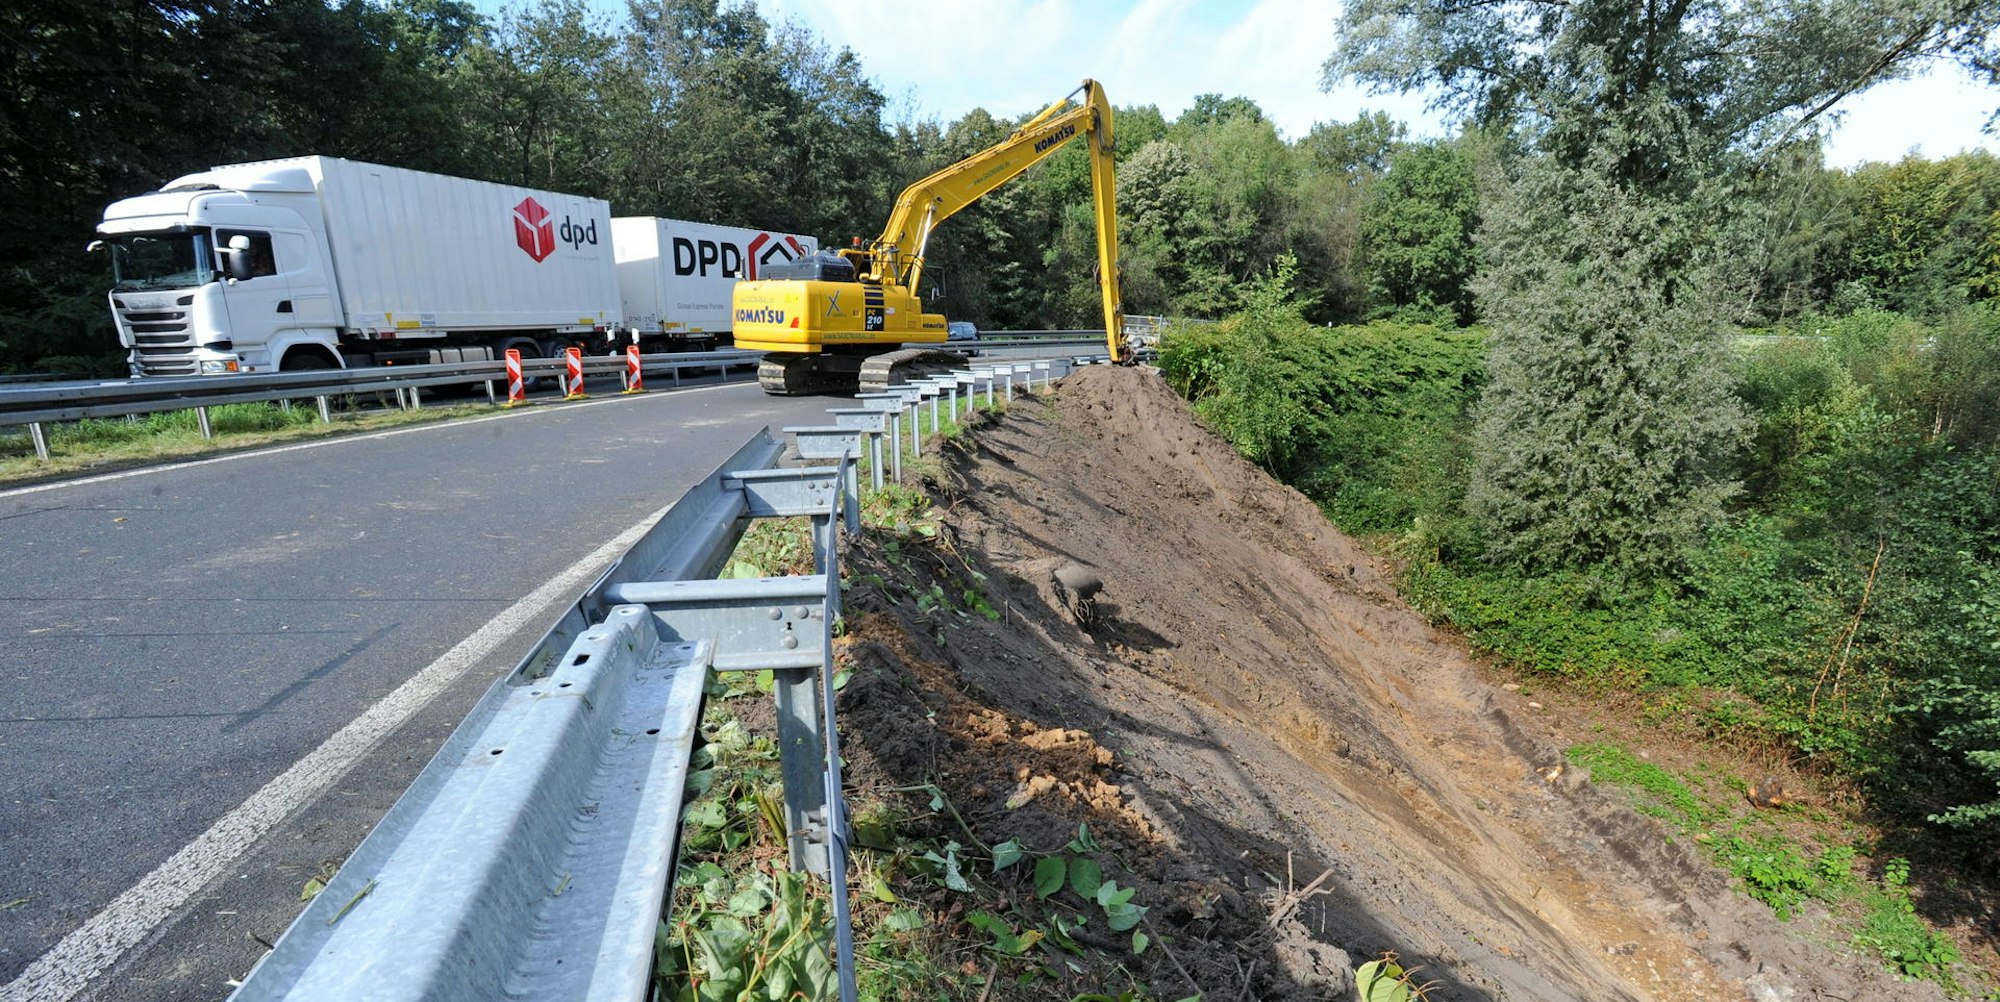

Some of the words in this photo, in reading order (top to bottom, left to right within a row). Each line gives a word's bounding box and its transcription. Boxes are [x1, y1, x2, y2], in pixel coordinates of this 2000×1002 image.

[1034, 124, 1075, 153] KOMATSU
[560, 215, 598, 250] dpd
[672, 237, 741, 279] DPD
[735, 306, 784, 325] KOMATSU
[867, 316, 882, 324] 210
